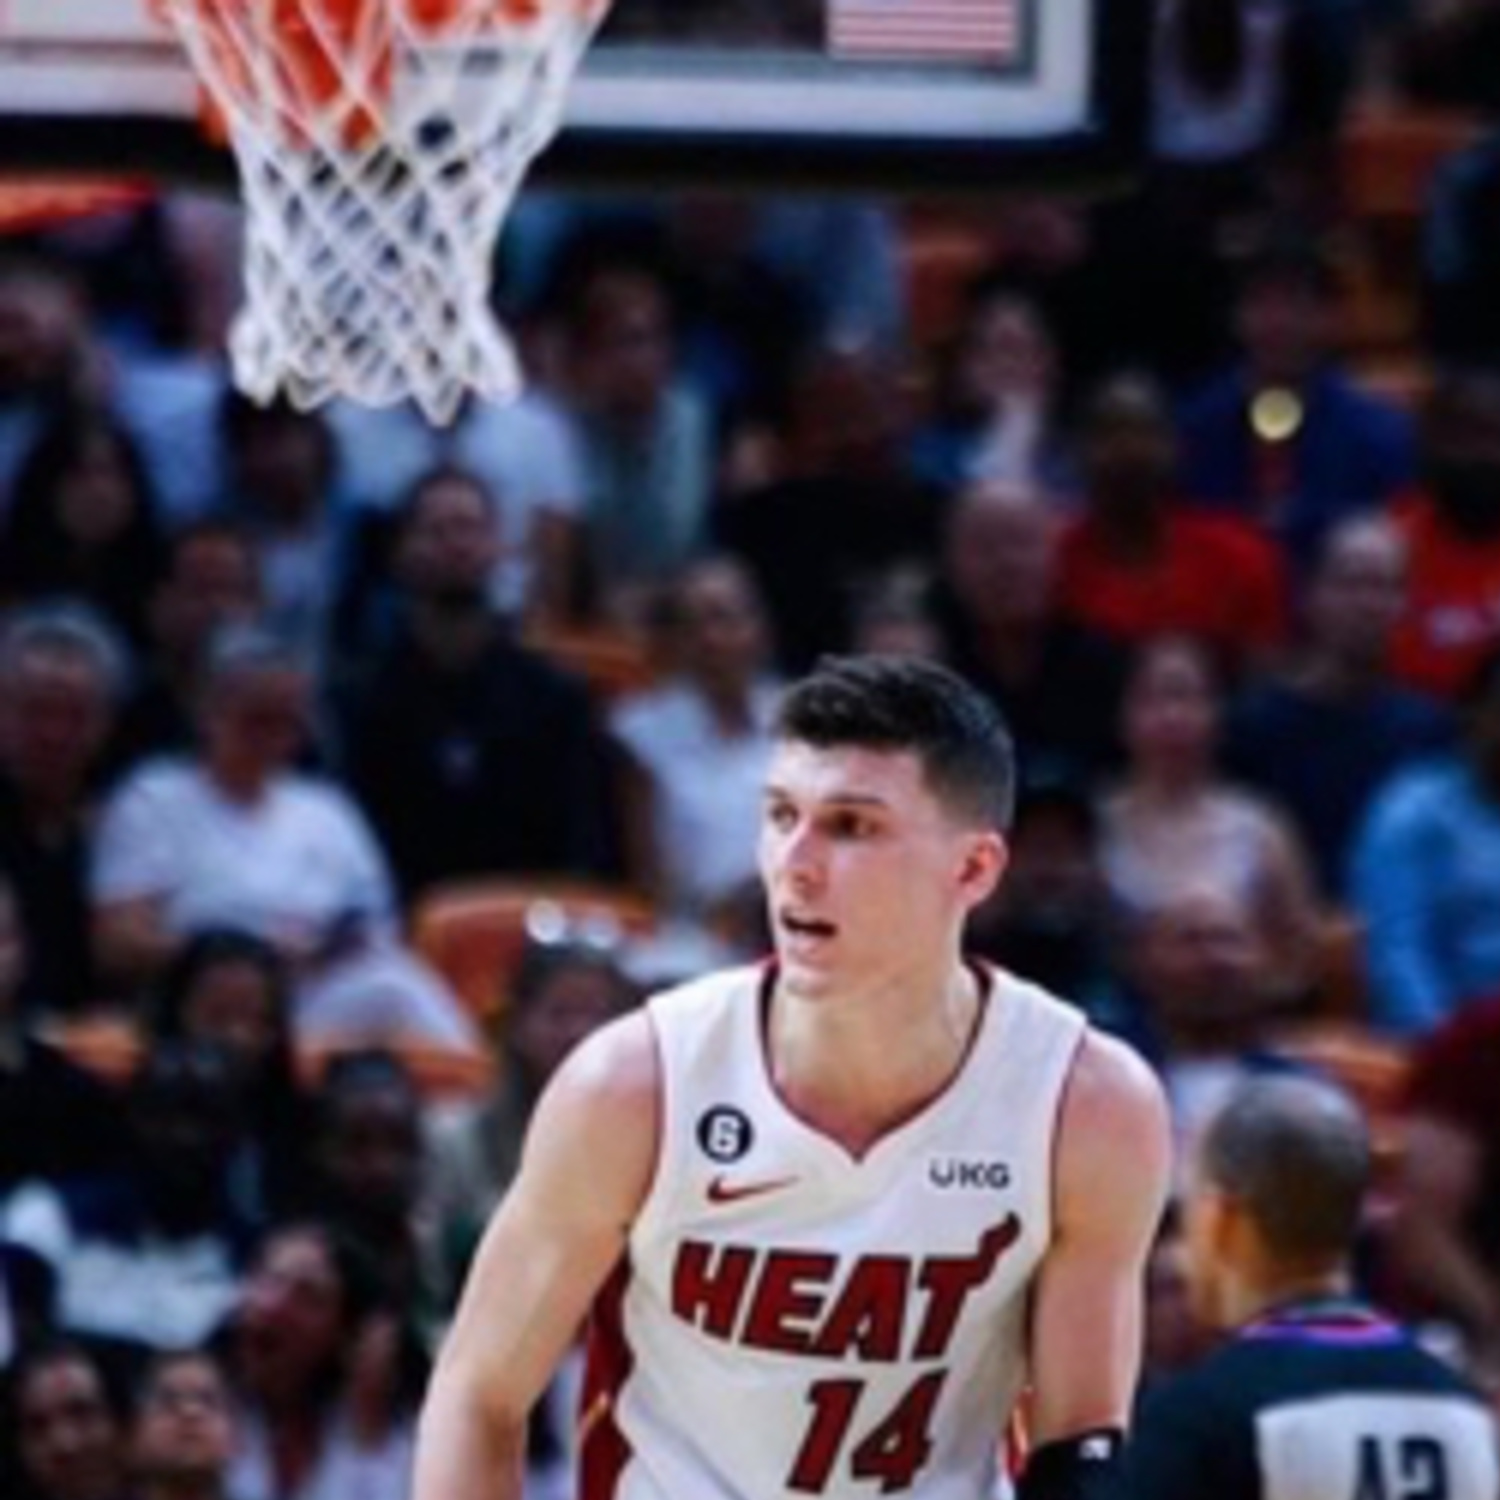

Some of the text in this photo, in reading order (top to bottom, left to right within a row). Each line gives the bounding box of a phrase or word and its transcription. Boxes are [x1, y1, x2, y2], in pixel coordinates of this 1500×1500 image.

[929, 1159, 1011, 1190] UKG
[671, 1211, 1021, 1362] HEAT
[784, 1369, 950, 1496] 14
